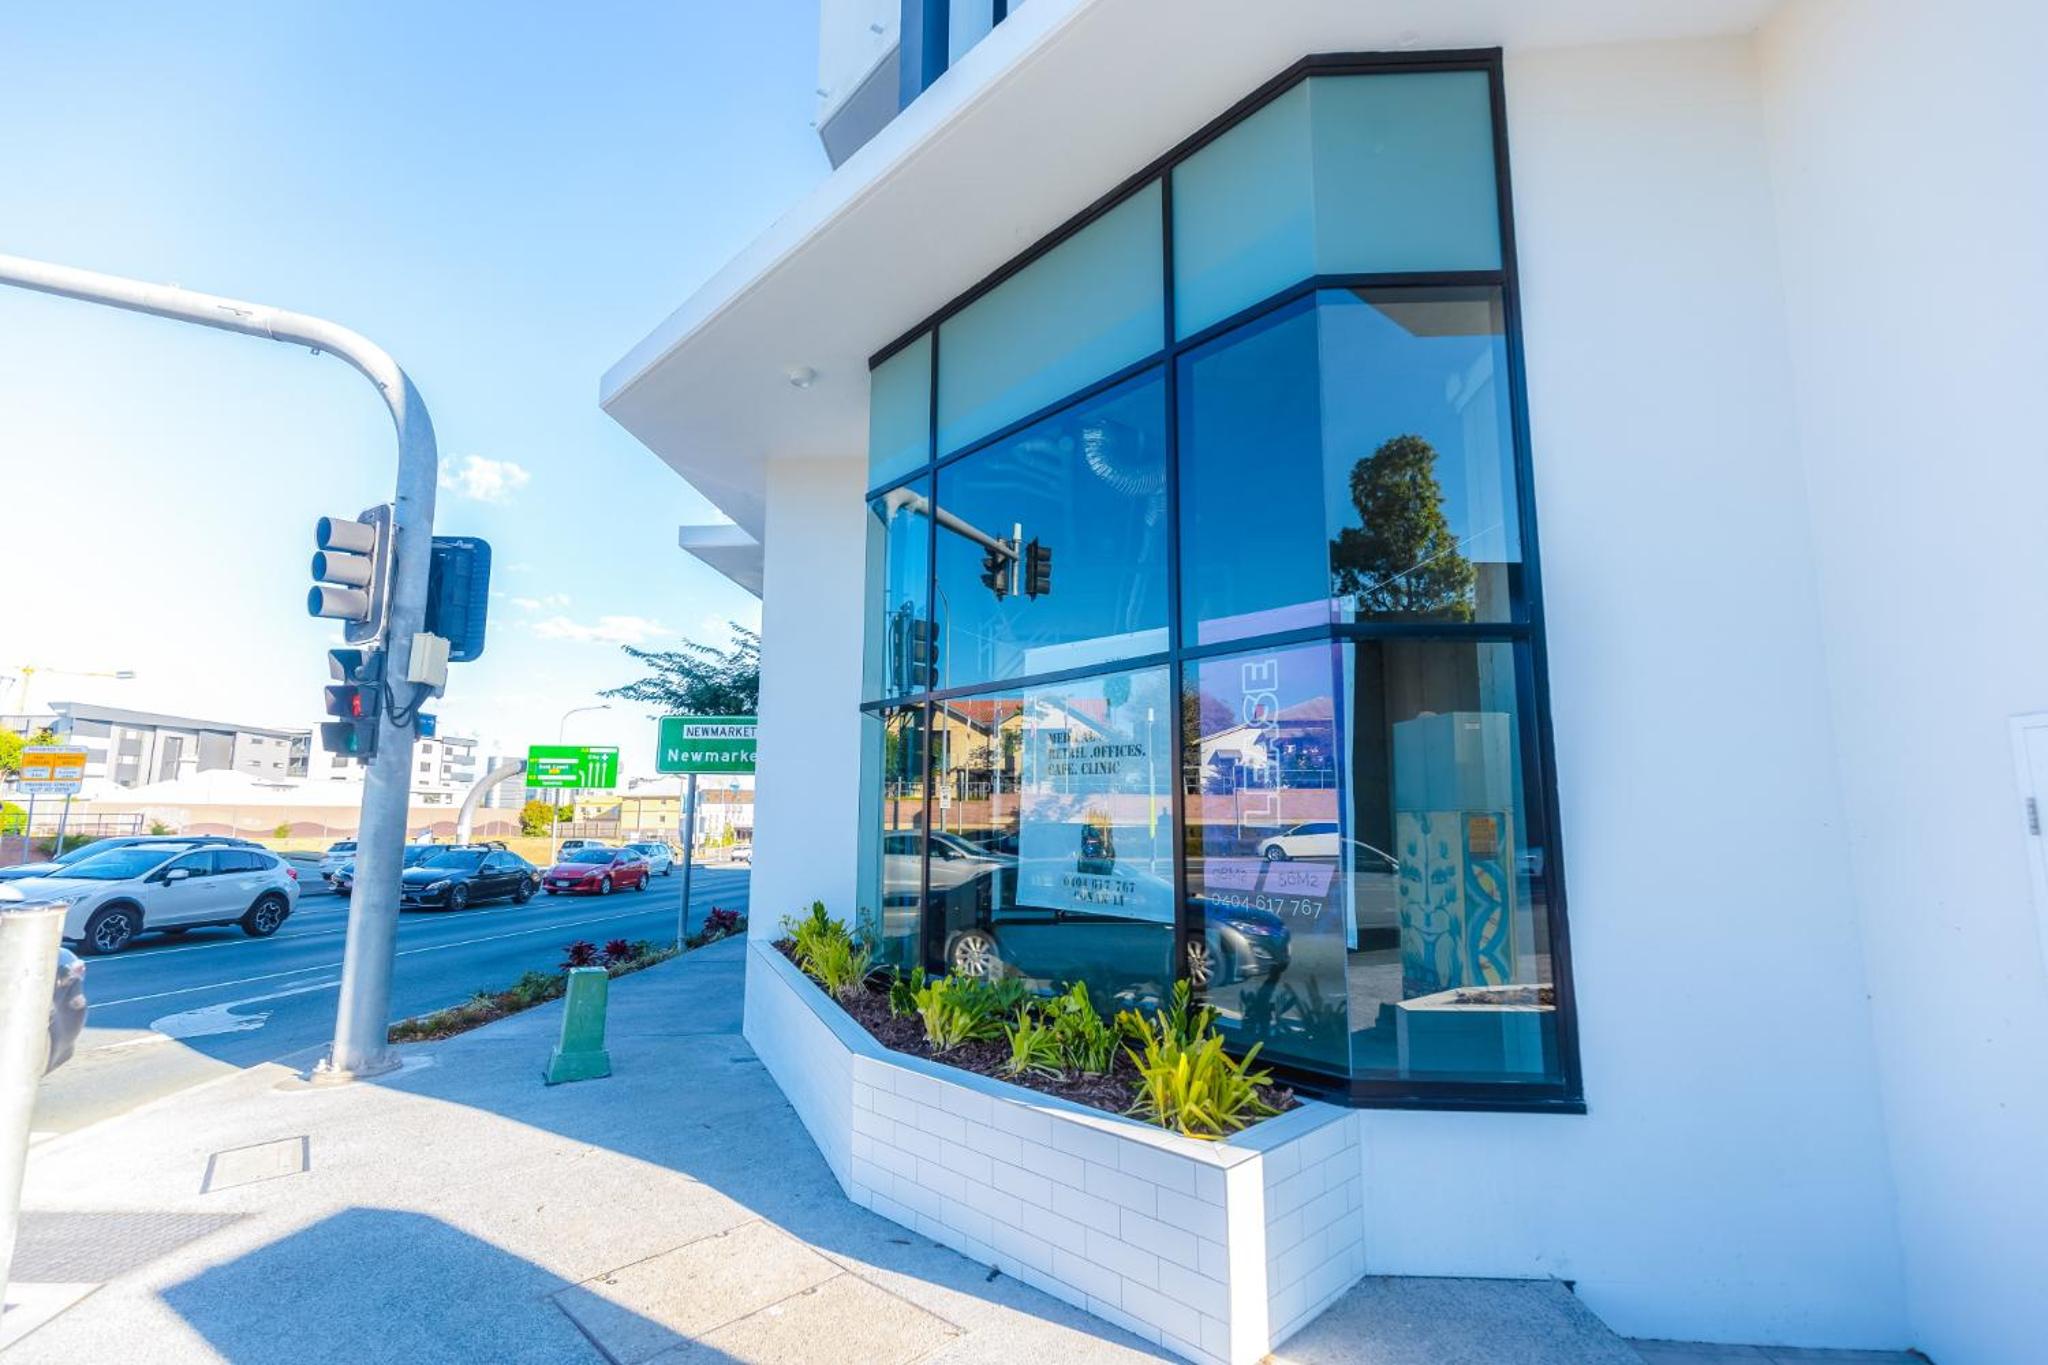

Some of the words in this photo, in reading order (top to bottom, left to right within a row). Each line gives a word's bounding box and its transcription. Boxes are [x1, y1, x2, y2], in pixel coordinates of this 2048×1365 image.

[686, 727, 757, 737] NEWMARKET
[1242, 659, 1281, 828] LEASE
[1081, 761, 1120, 775] CLINIC
[1211, 893, 1250, 912] 0404
[1256, 895, 1284, 915] 617
[1290, 899, 1323, 919] 767
